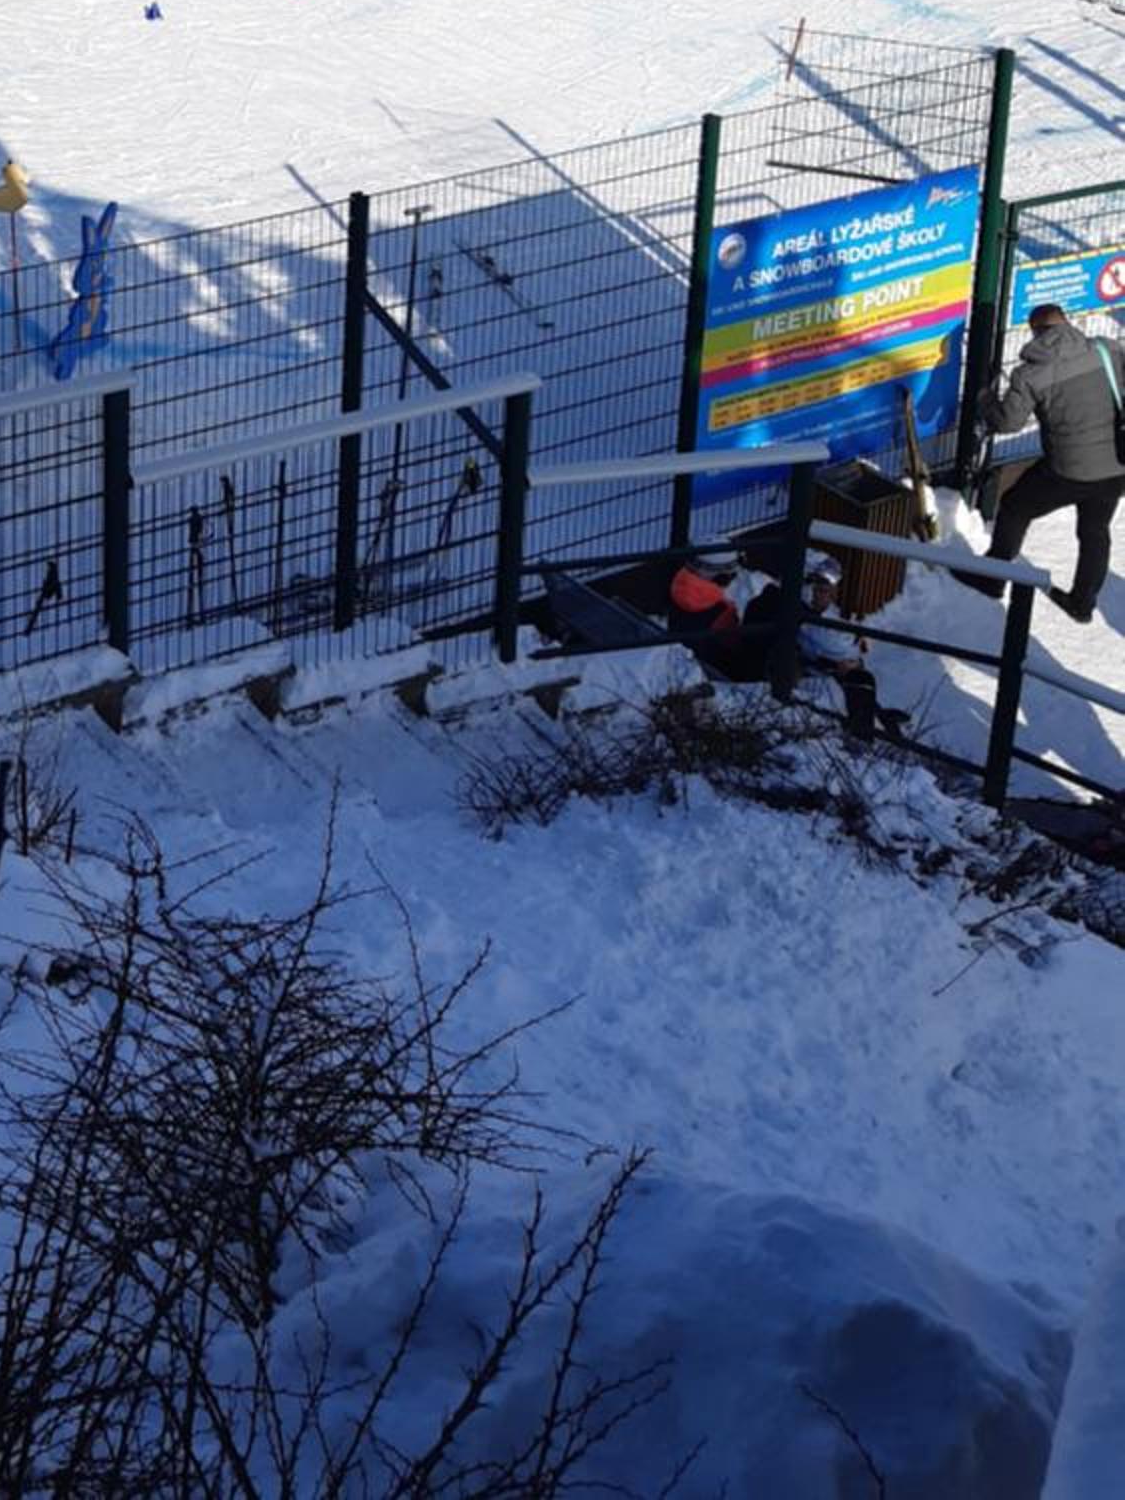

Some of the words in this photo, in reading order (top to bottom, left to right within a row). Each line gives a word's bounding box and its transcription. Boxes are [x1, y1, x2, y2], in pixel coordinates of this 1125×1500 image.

[732, 275, 745, 292] A
[749, 237, 893, 288] SNOWBOARDOVÉ
[897, 222, 947, 250] ŠKOLY
[772, 227, 825, 259] AREÁL
[831, 204, 915, 244] LYŽAŘSKÉ
[752, 296, 856, 340] MEETING
[862, 276, 924, 314] POINT
